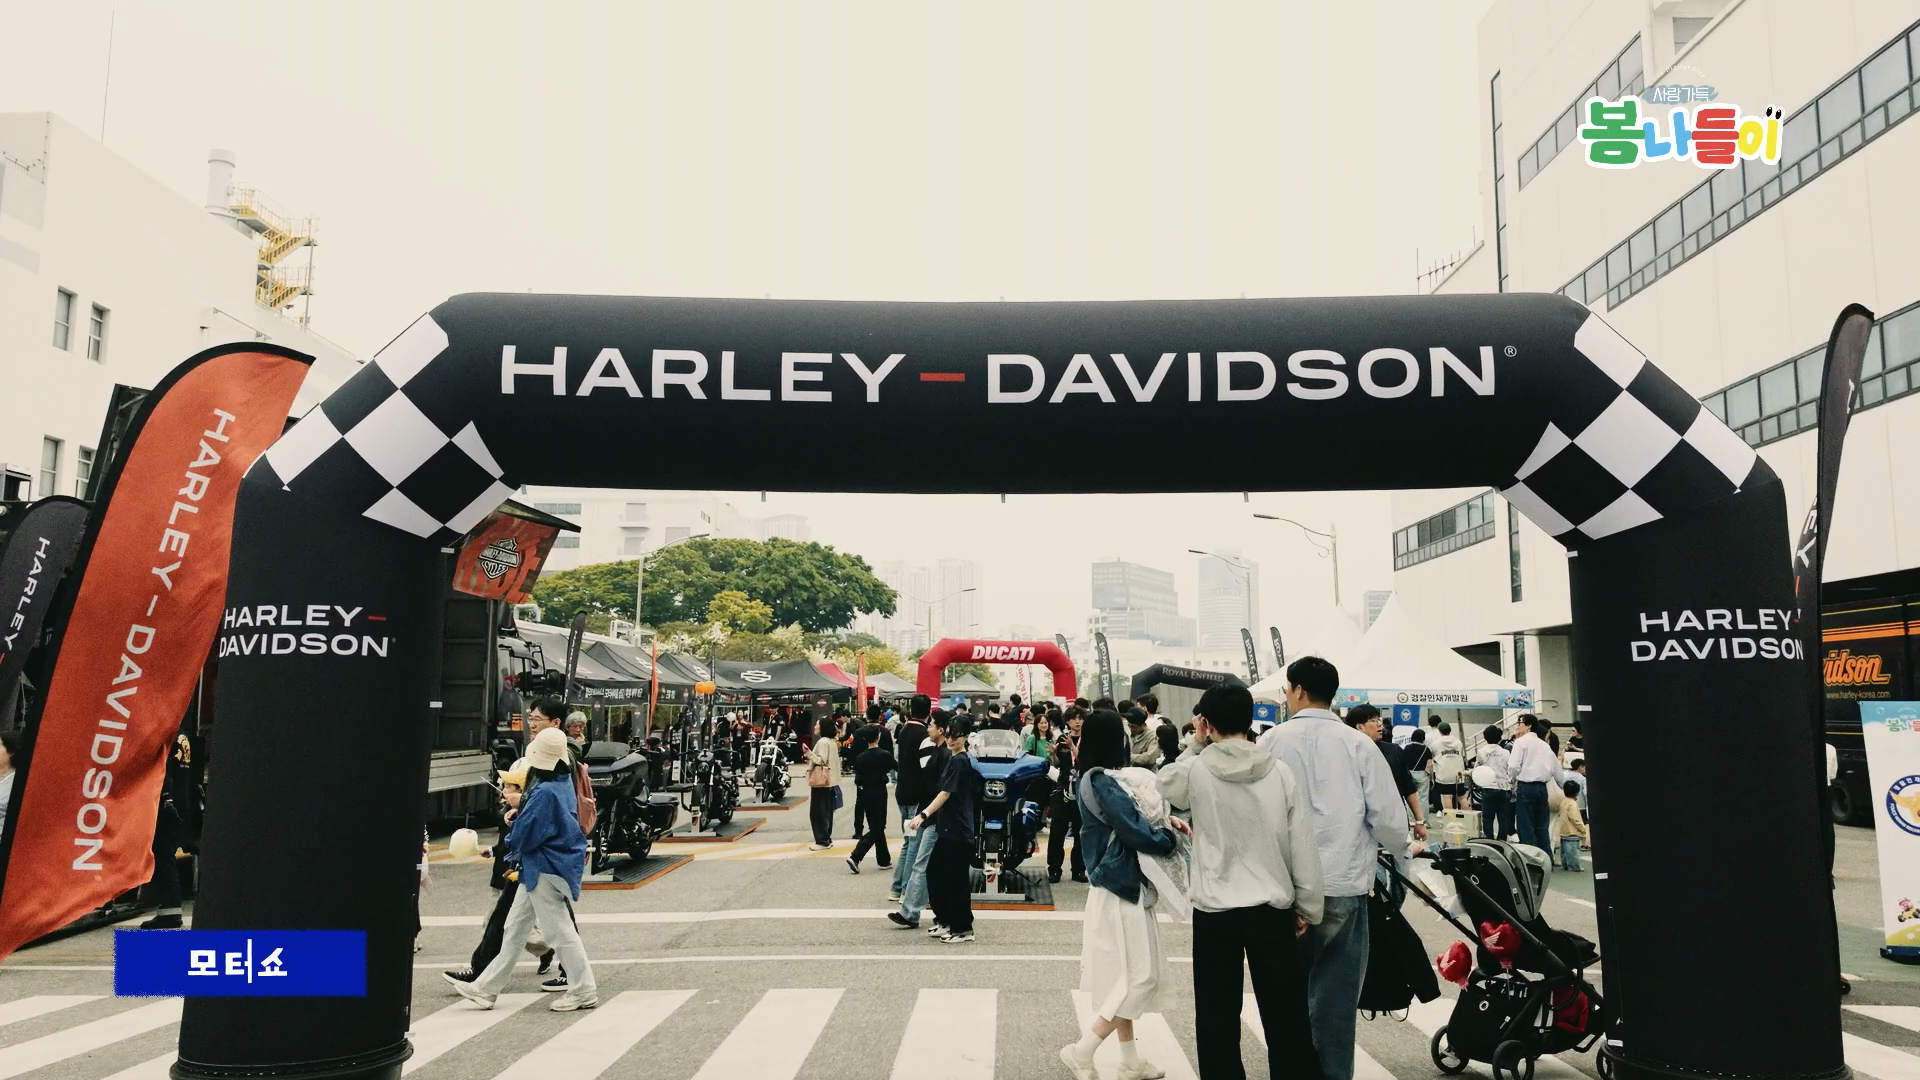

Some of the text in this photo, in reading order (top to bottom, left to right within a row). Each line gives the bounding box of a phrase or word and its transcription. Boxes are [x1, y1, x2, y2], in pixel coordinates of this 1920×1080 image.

[4, 536, 51, 651] HARLEY
[219, 633, 388, 658] DAVIDSON
[971, 645, 1036, 661] DUCATI
[1630, 637, 1804, 662] DAVIDSON
[1162, 667, 1225, 682] ROYAL ENFIELD
[1411, 693, 1468, 703] 경찰인재개발원
[1826, 690, 1890, 700] www.harley-korea.com
